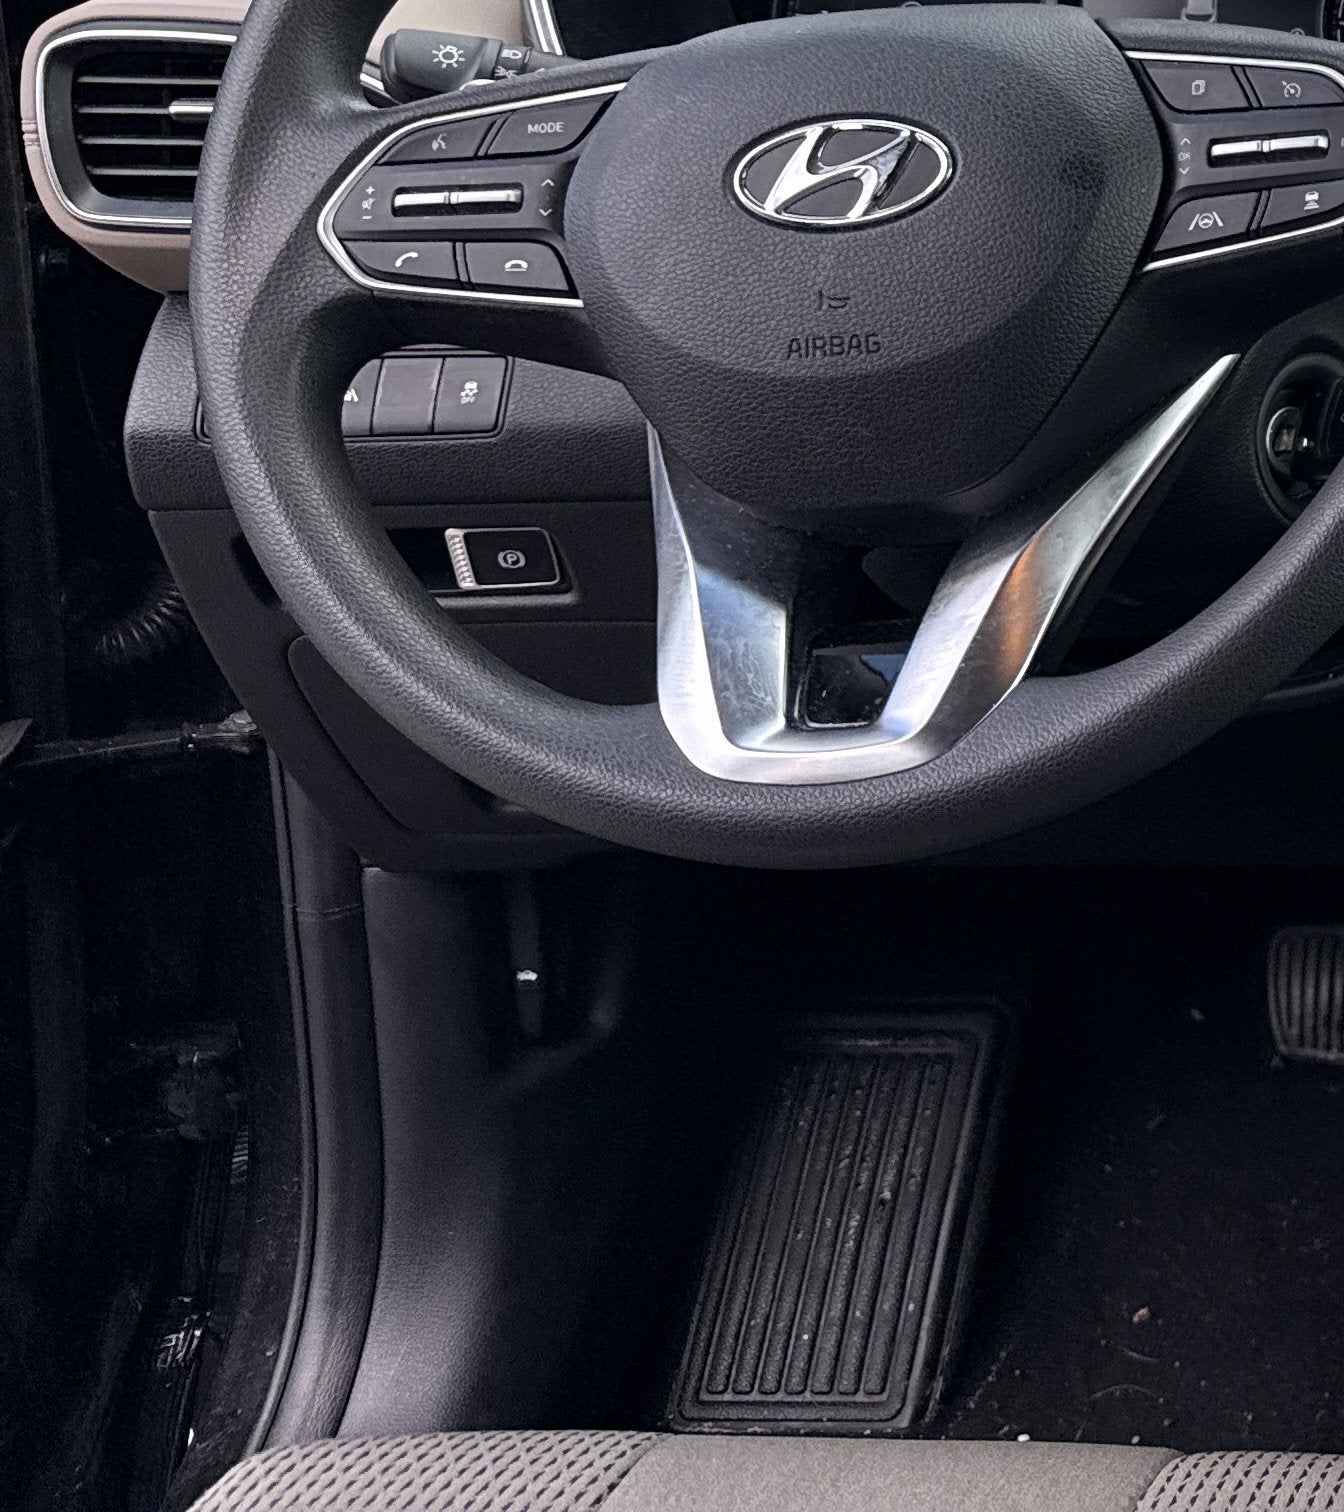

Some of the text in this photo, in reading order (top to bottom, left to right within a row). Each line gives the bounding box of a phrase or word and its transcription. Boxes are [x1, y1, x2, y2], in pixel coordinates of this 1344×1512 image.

[528, 122, 564, 134] MODE
[1178, 152, 1191, 161] OK
[785, 333, 882, 360] AIRBAG
